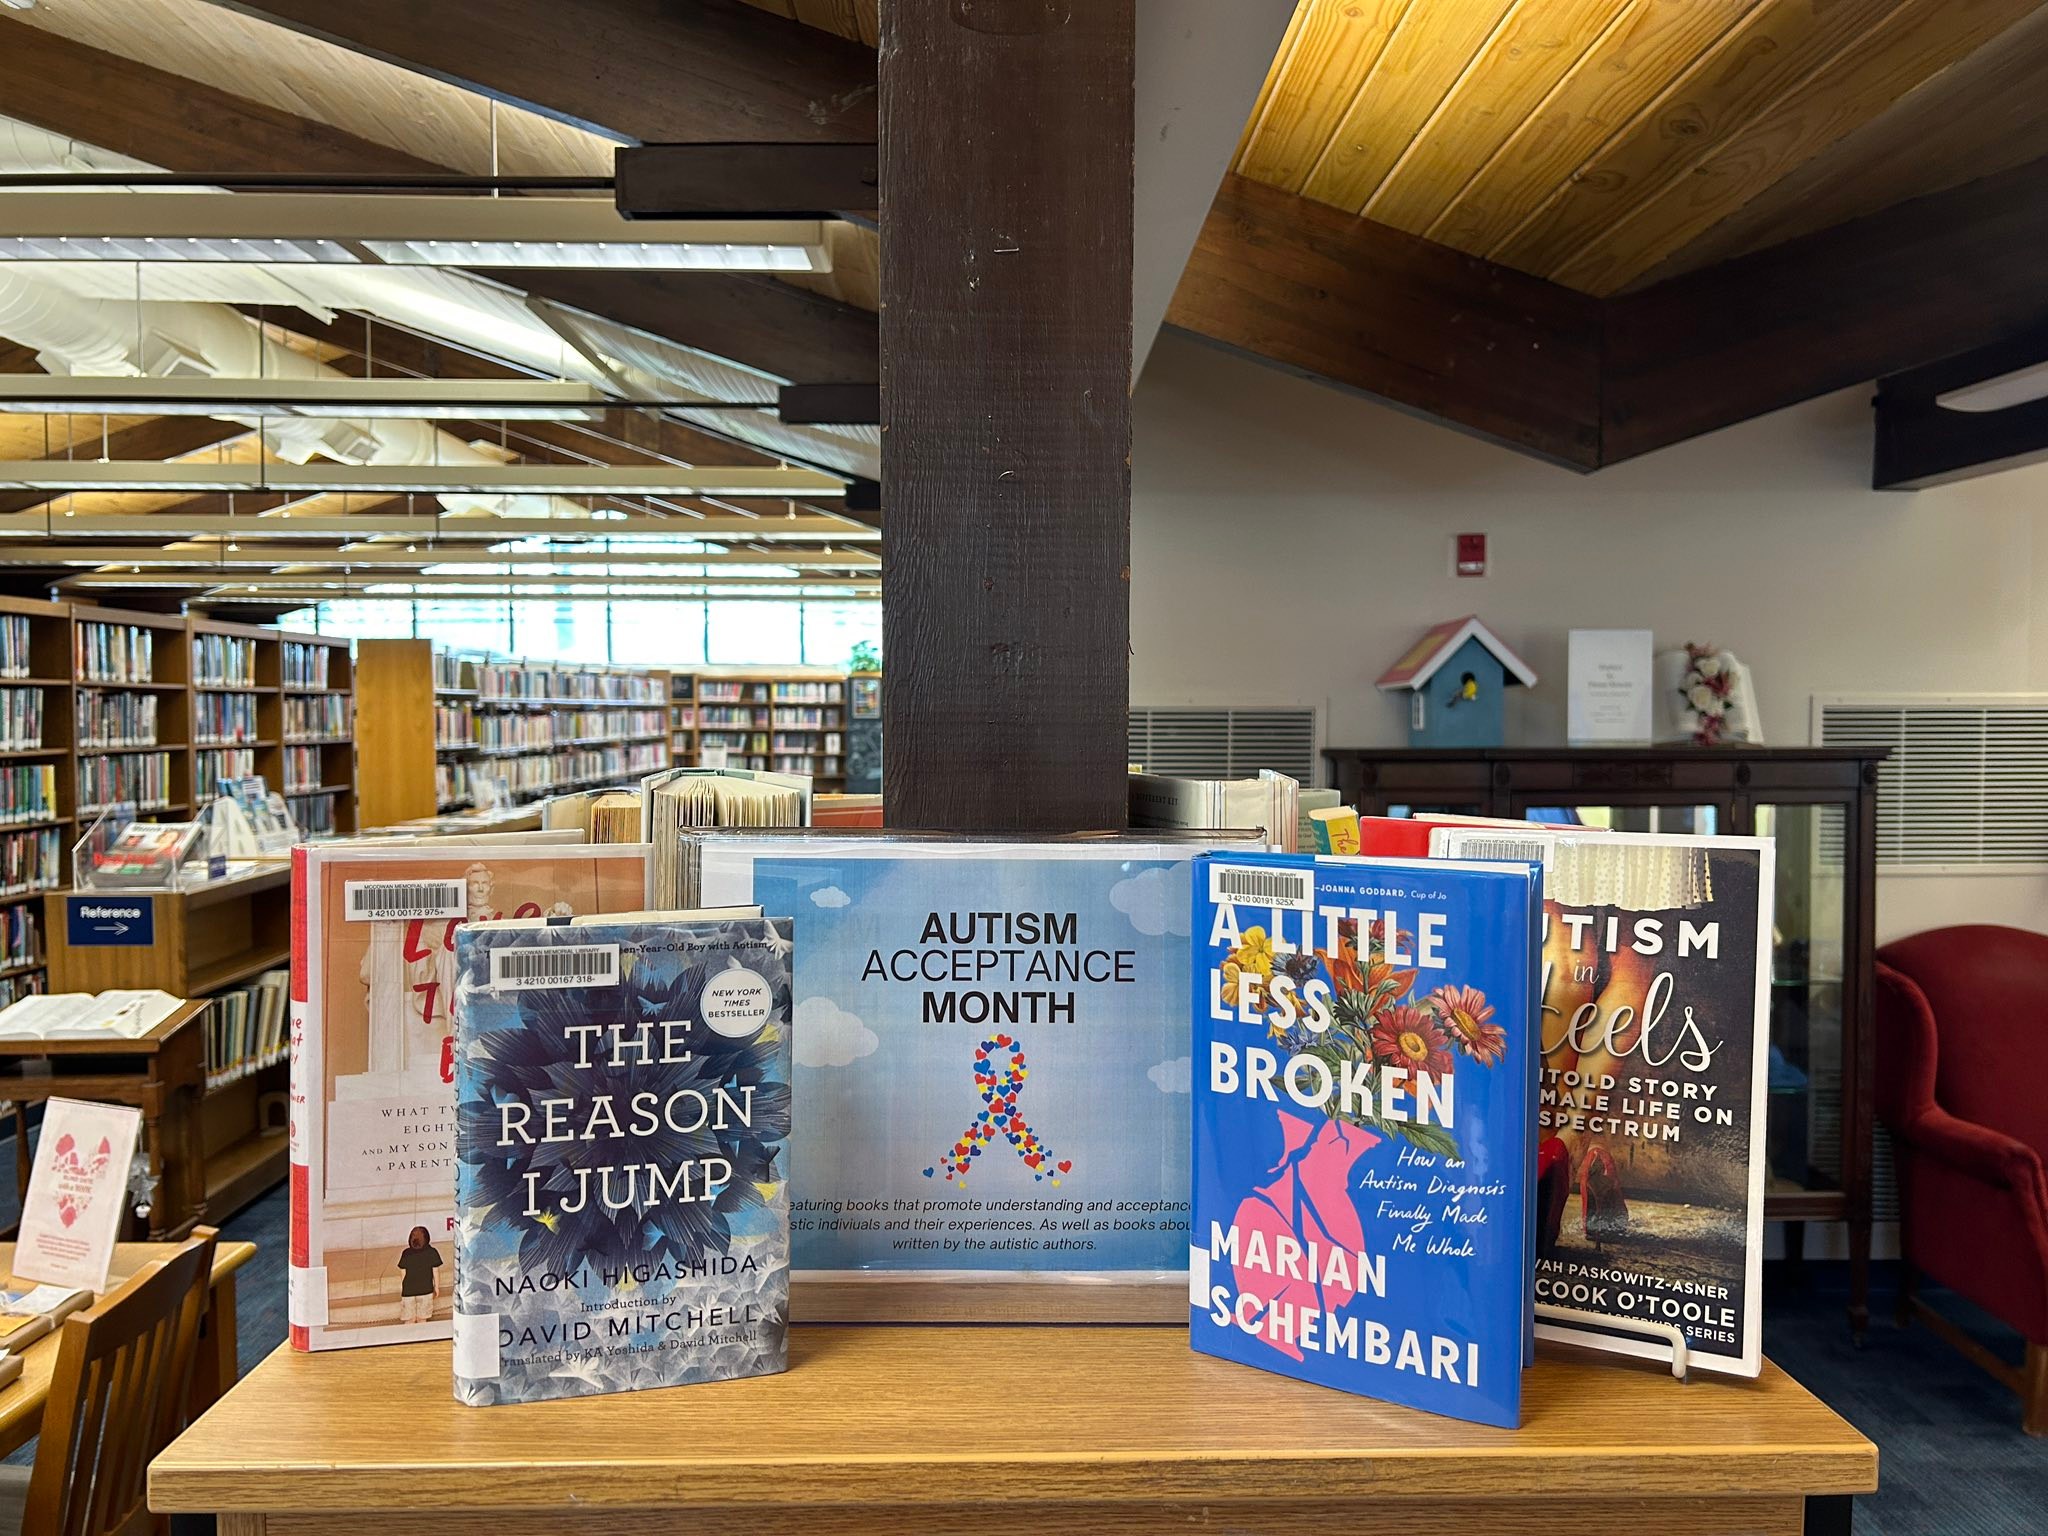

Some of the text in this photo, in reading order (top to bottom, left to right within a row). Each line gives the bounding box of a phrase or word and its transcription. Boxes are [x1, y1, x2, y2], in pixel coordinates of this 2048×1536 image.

[1233, 895, 1251, 903] 4210
[1252, 897, 1274, 905] 00191
[1276, 899, 1295, 907] 525X
[1359, 886, 1406, 898] GODDARD,
[1411, 890, 1427, 901] Cup
[1428, 890, 1437, 900] of
[1438, 892, 1447, 900] Jo
[80, 906, 141, 919] Reference
[368, 908, 445, 918] 3 4210 00172 975+
[919, 912, 1078, 945] AUTISM
[1209, 903, 1447, 969] A LITTLE
[687, 942, 706, 953] Boy
[707, 941, 730, 950] with
[862, 949, 1136, 982] ACCEPTANCE
[1573, 959, 1599, 984] in
[516, 978, 522, 986] 3
[524, 977, 546, 985] 4210
[548, 976, 574, 985] 00167
[712, 987, 762, 998] NEW YORK
[708, 1008, 765, 1018] BESTSELLER
[724, 999, 750, 1007] TIMES
[922, 991, 1075, 1024] MONTH
[1210, 968, 1331, 1034] LESS
[564, 1020, 692, 1069] THE
[1210, 1041, 1454, 1129] BROKEN
[1628, 1077, 1717, 1101] STORY
[382, 1106, 429, 1117] WHAT
[496, 1085, 756, 1146] REASON
[1622, 1098, 1681, 1120] LIFE
[1694, 1106, 1733, 1126] ON
[404, 1123, 455, 1134] EIGHT
[1538, 1112, 1680, 1142] SPECTRUM
[362, 1142, 448, 1156] AND MY SON
[1397, 1146, 1465, 1169] How an
[388, 1158, 452, 1170] PARENT
[522, 1157, 732, 1216] I JUMP
[1359, 1169, 1507, 1203] Autism Diagnosis
[846, 1199, 889, 1211] books
[892, 1199, 921, 1211] that
[922, 1200, 982, 1215] promote
[985, 1199, 1083, 1215] understanding
[1086, 1199, 1113, 1211] and
[1377, 1200, 1488, 1233] Finally Made
[818, 1218, 880, 1231] indiviuals
[884, 1218, 910, 1231] and
[914, 1218, 944, 1231] their
[948, 1218, 1036, 1234] experiences.
[1039, 1218, 1059, 1231] As
[1062, 1218, 1090, 1231] well
[1093, 1221, 1110, 1231] as
[1113, 1218, 1155, 1231] books
[893, 1238, 1097, 1254] written by the autistic authors.
[1392, 1233, 1476, 1257] Me Whole
[1211, 1220, 1386, 1298] MARIAN
[495, 1254, 758, 1296] NAOKI HIGASHIDA
[1568, 1264, 1729, 1301] PASKOWITZ-ASNER
[580, 1294, 676, 1313] Introduction by
[1535, 1278, 1608, 1307] COOK
[1616, 1291, 1735, 1328] O'TOOLE
[499, 1305, 758, 1348] DAVID MITCHELL
[1210, 1285, 1478, 1388] SCHEMBARI
[1686, 1325, 1735, 1344] SERIES
[500, 1331, 757, 1367] ranslated by KA Yoshida & David Mitchell
